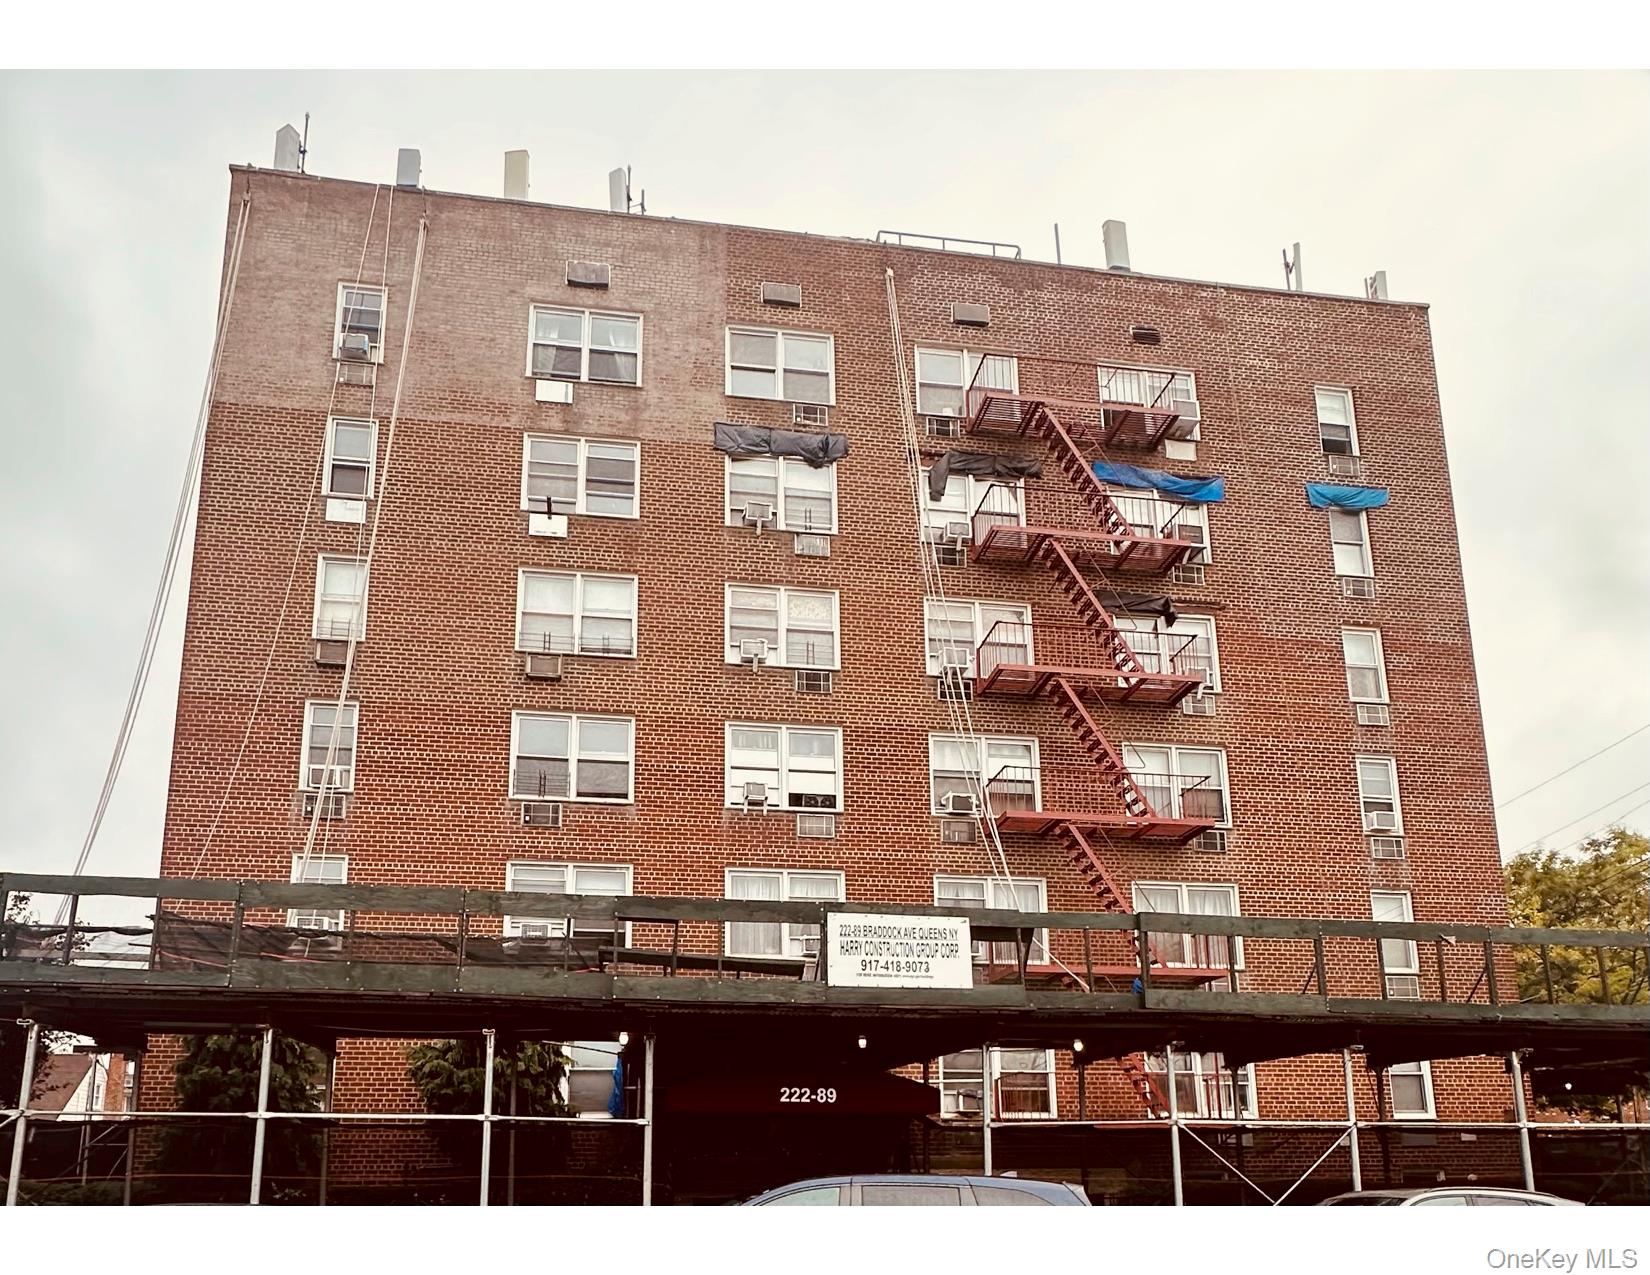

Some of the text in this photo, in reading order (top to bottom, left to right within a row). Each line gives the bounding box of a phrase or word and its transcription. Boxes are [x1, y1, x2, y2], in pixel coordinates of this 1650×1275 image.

[840, 925, 958, 940] 222-89 BRADDOCK AVE QUEENS NY
[840, 940, 863, 956] HARRY
[864, 941, 914, 958] CONSTRUCTION
[916, 943, 939, 958] GROUP
[861, 960, 929, 972] 917-418-9073
[780, 1087, 836, 1103] 222-89
